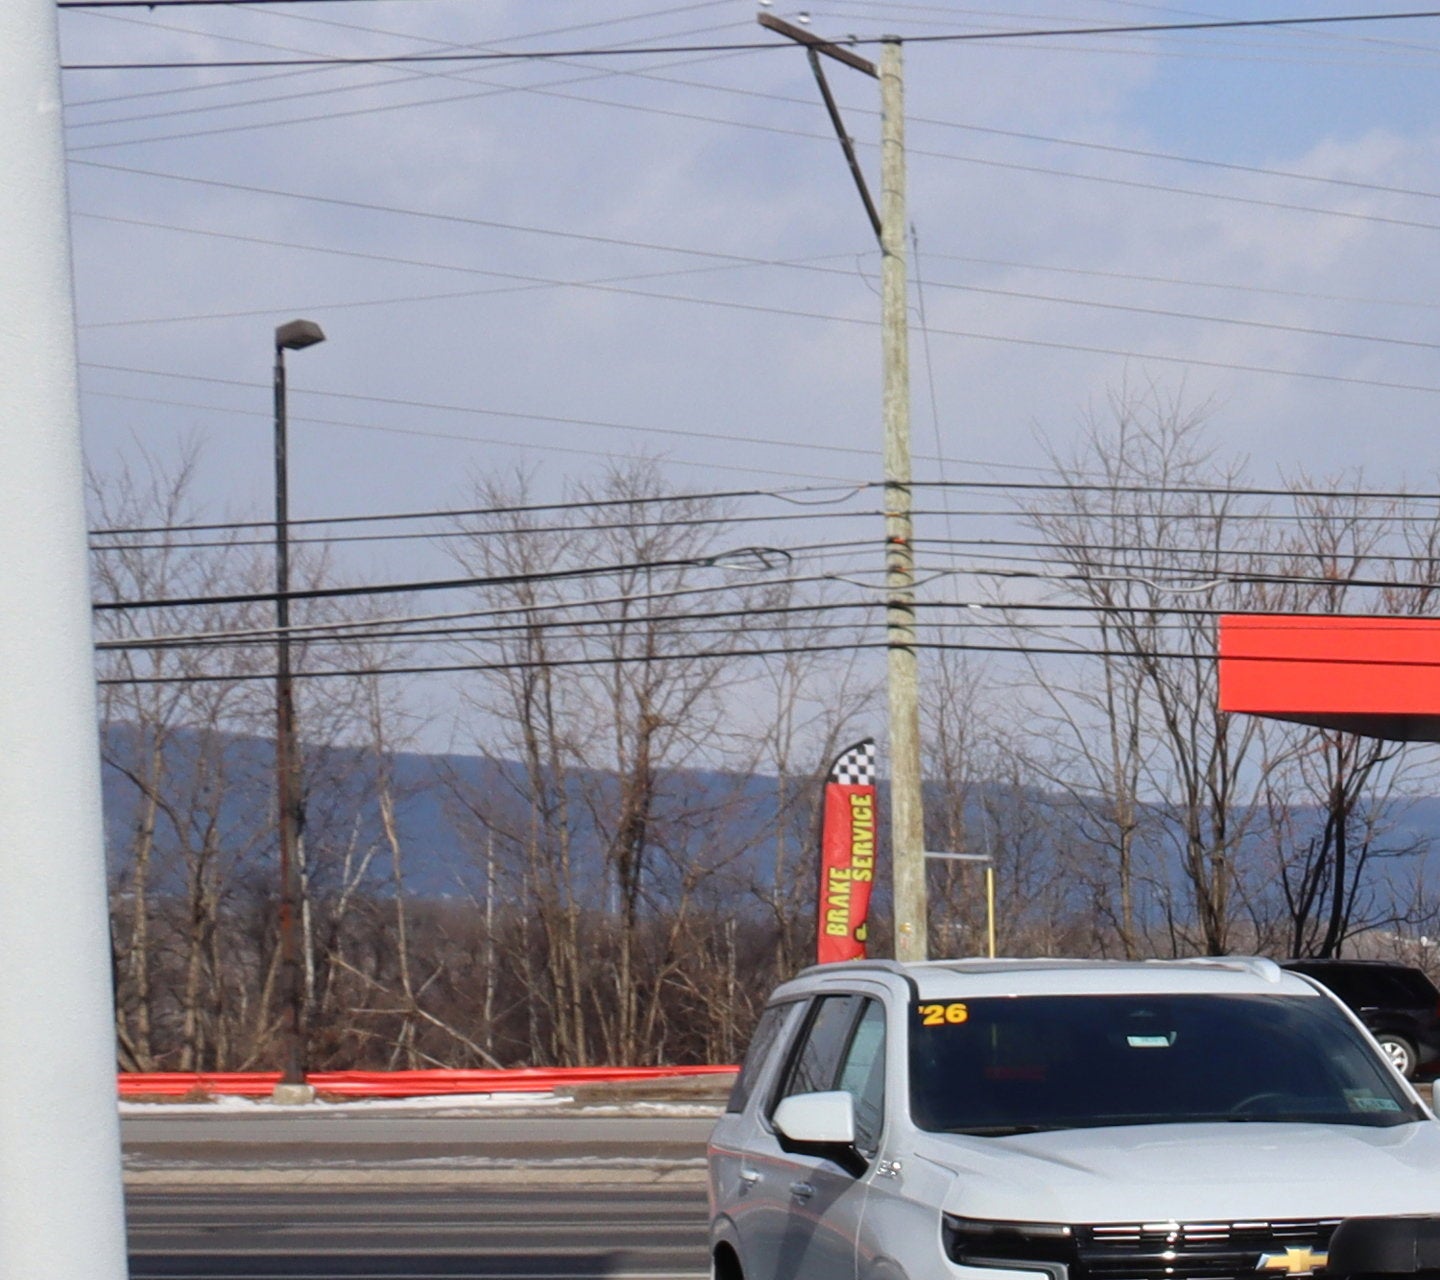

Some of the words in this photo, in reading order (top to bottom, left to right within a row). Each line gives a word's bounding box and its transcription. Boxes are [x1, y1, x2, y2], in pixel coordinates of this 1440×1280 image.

[851, 794, 875, 882] SERVICE
[826, 867, 851, 936] BRAKE
[917, 1003, 968, 1026] '26
